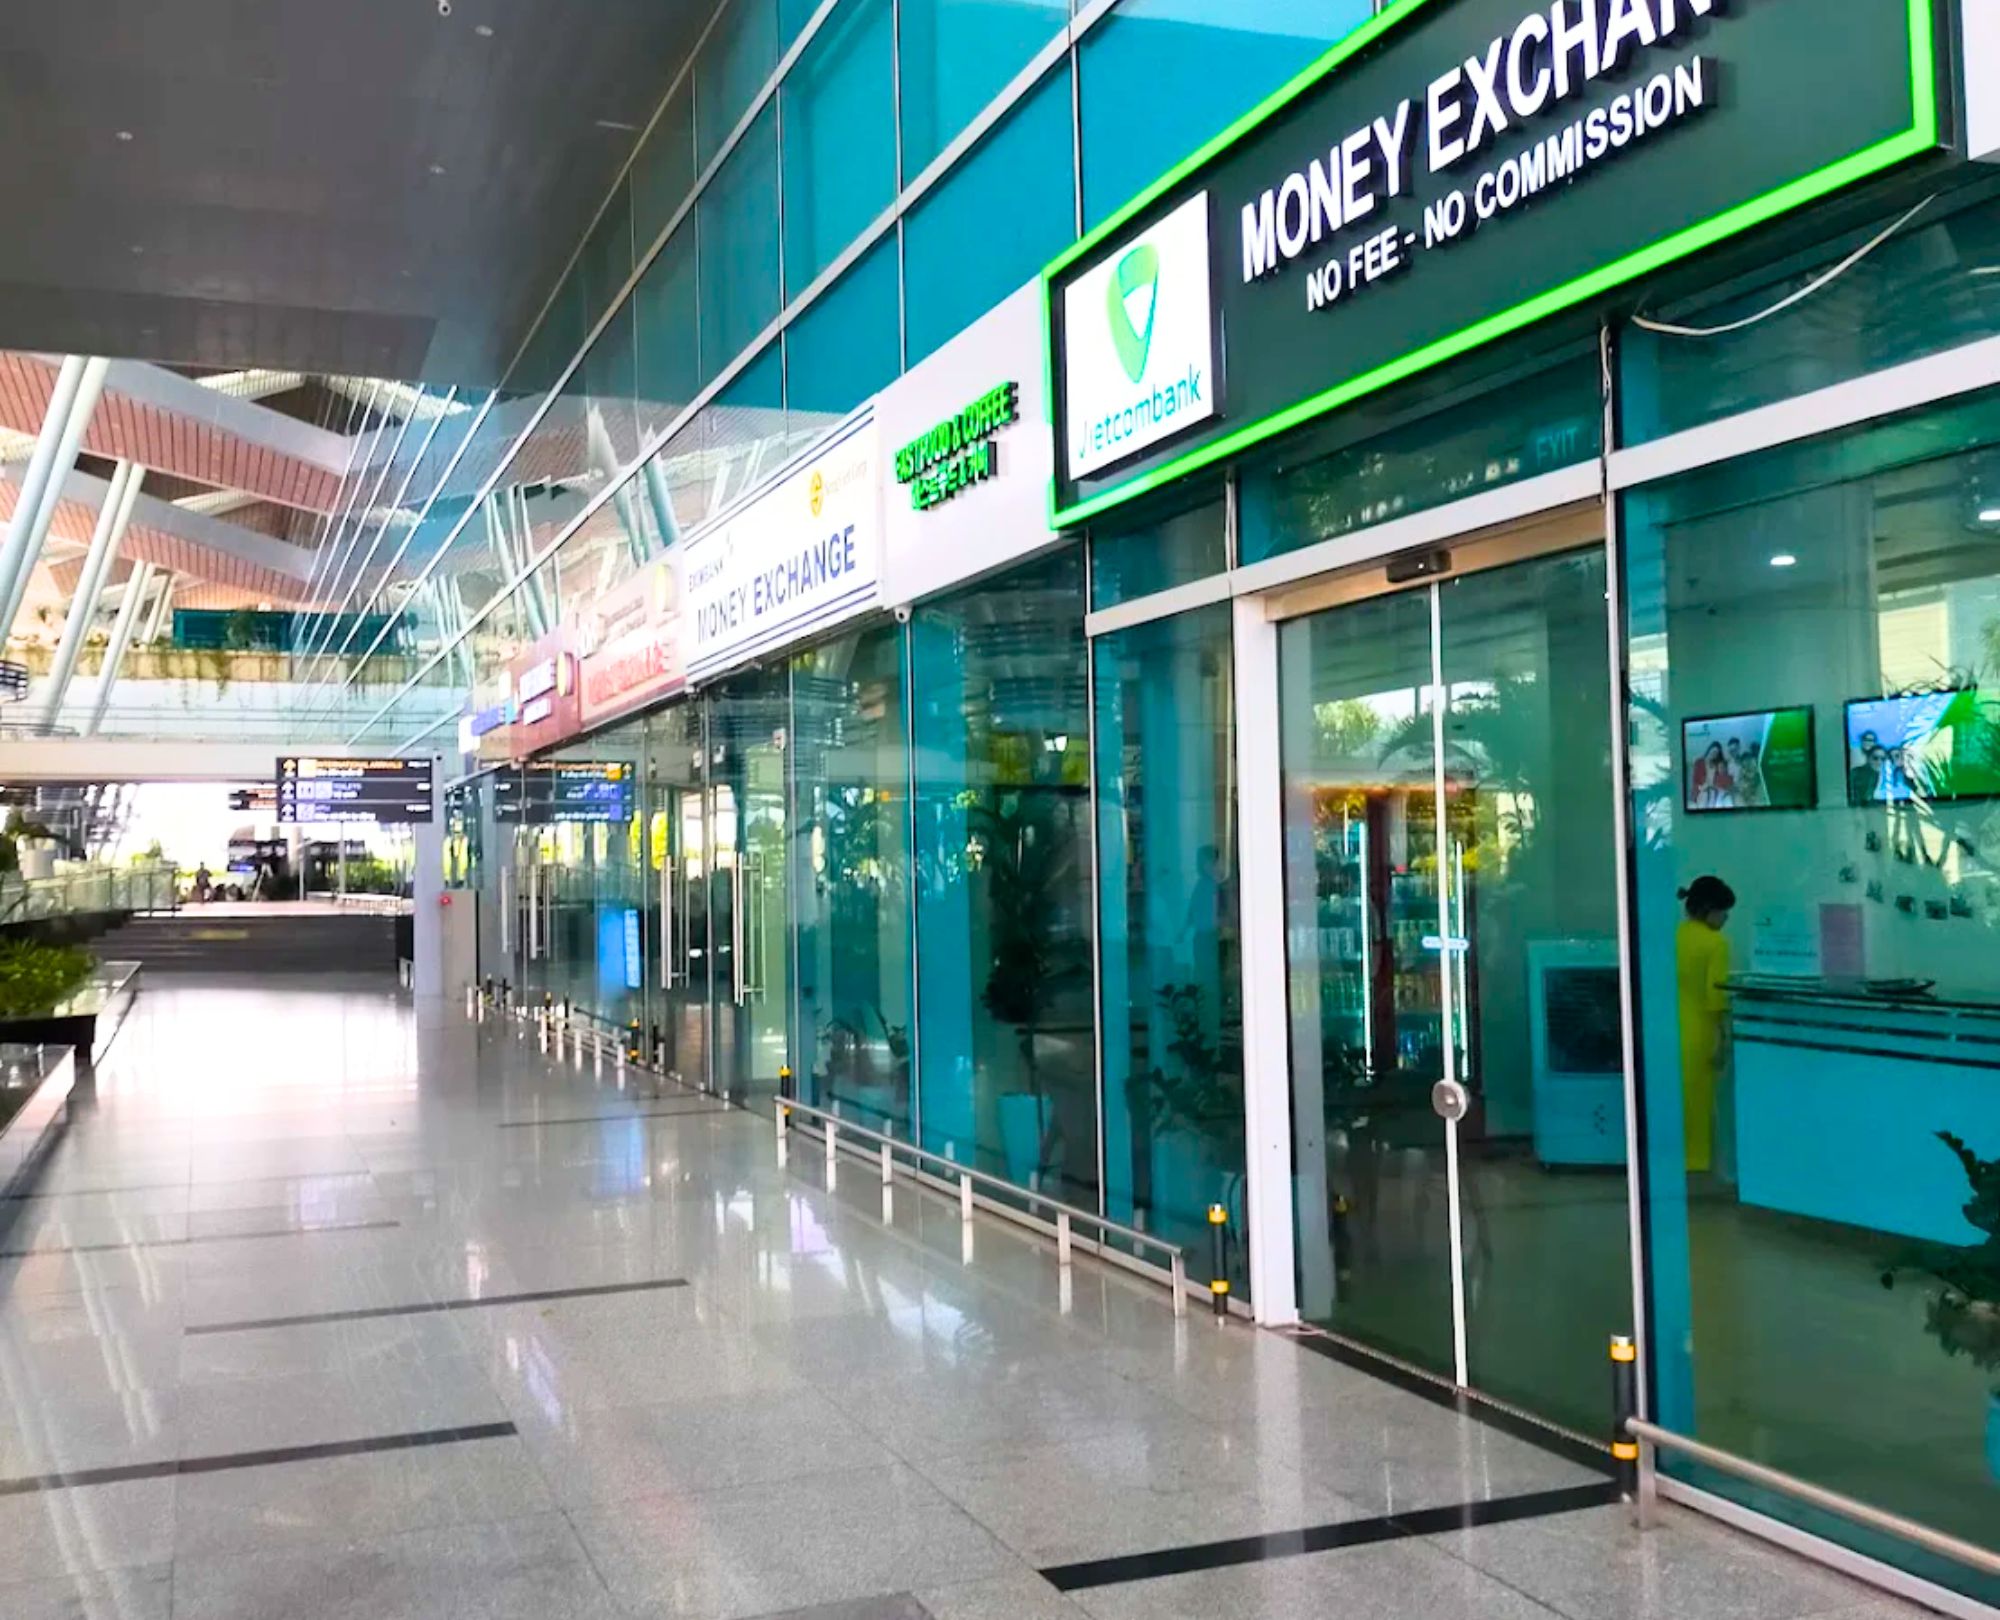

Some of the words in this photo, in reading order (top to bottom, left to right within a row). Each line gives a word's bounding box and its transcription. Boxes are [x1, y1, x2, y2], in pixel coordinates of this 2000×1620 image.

[1241, 99, 1410, 283] MONEY
[1306, 259, 1342, 312] NO
[1348, 226, 1400, 288] FEE
[1424, 190, 1466, 249] NO
[1475, 56, 1703, 219] COMMISSION
[698, 583, 748, 644] MONEY
[754, 524, 855, 616] EXCHANGE
